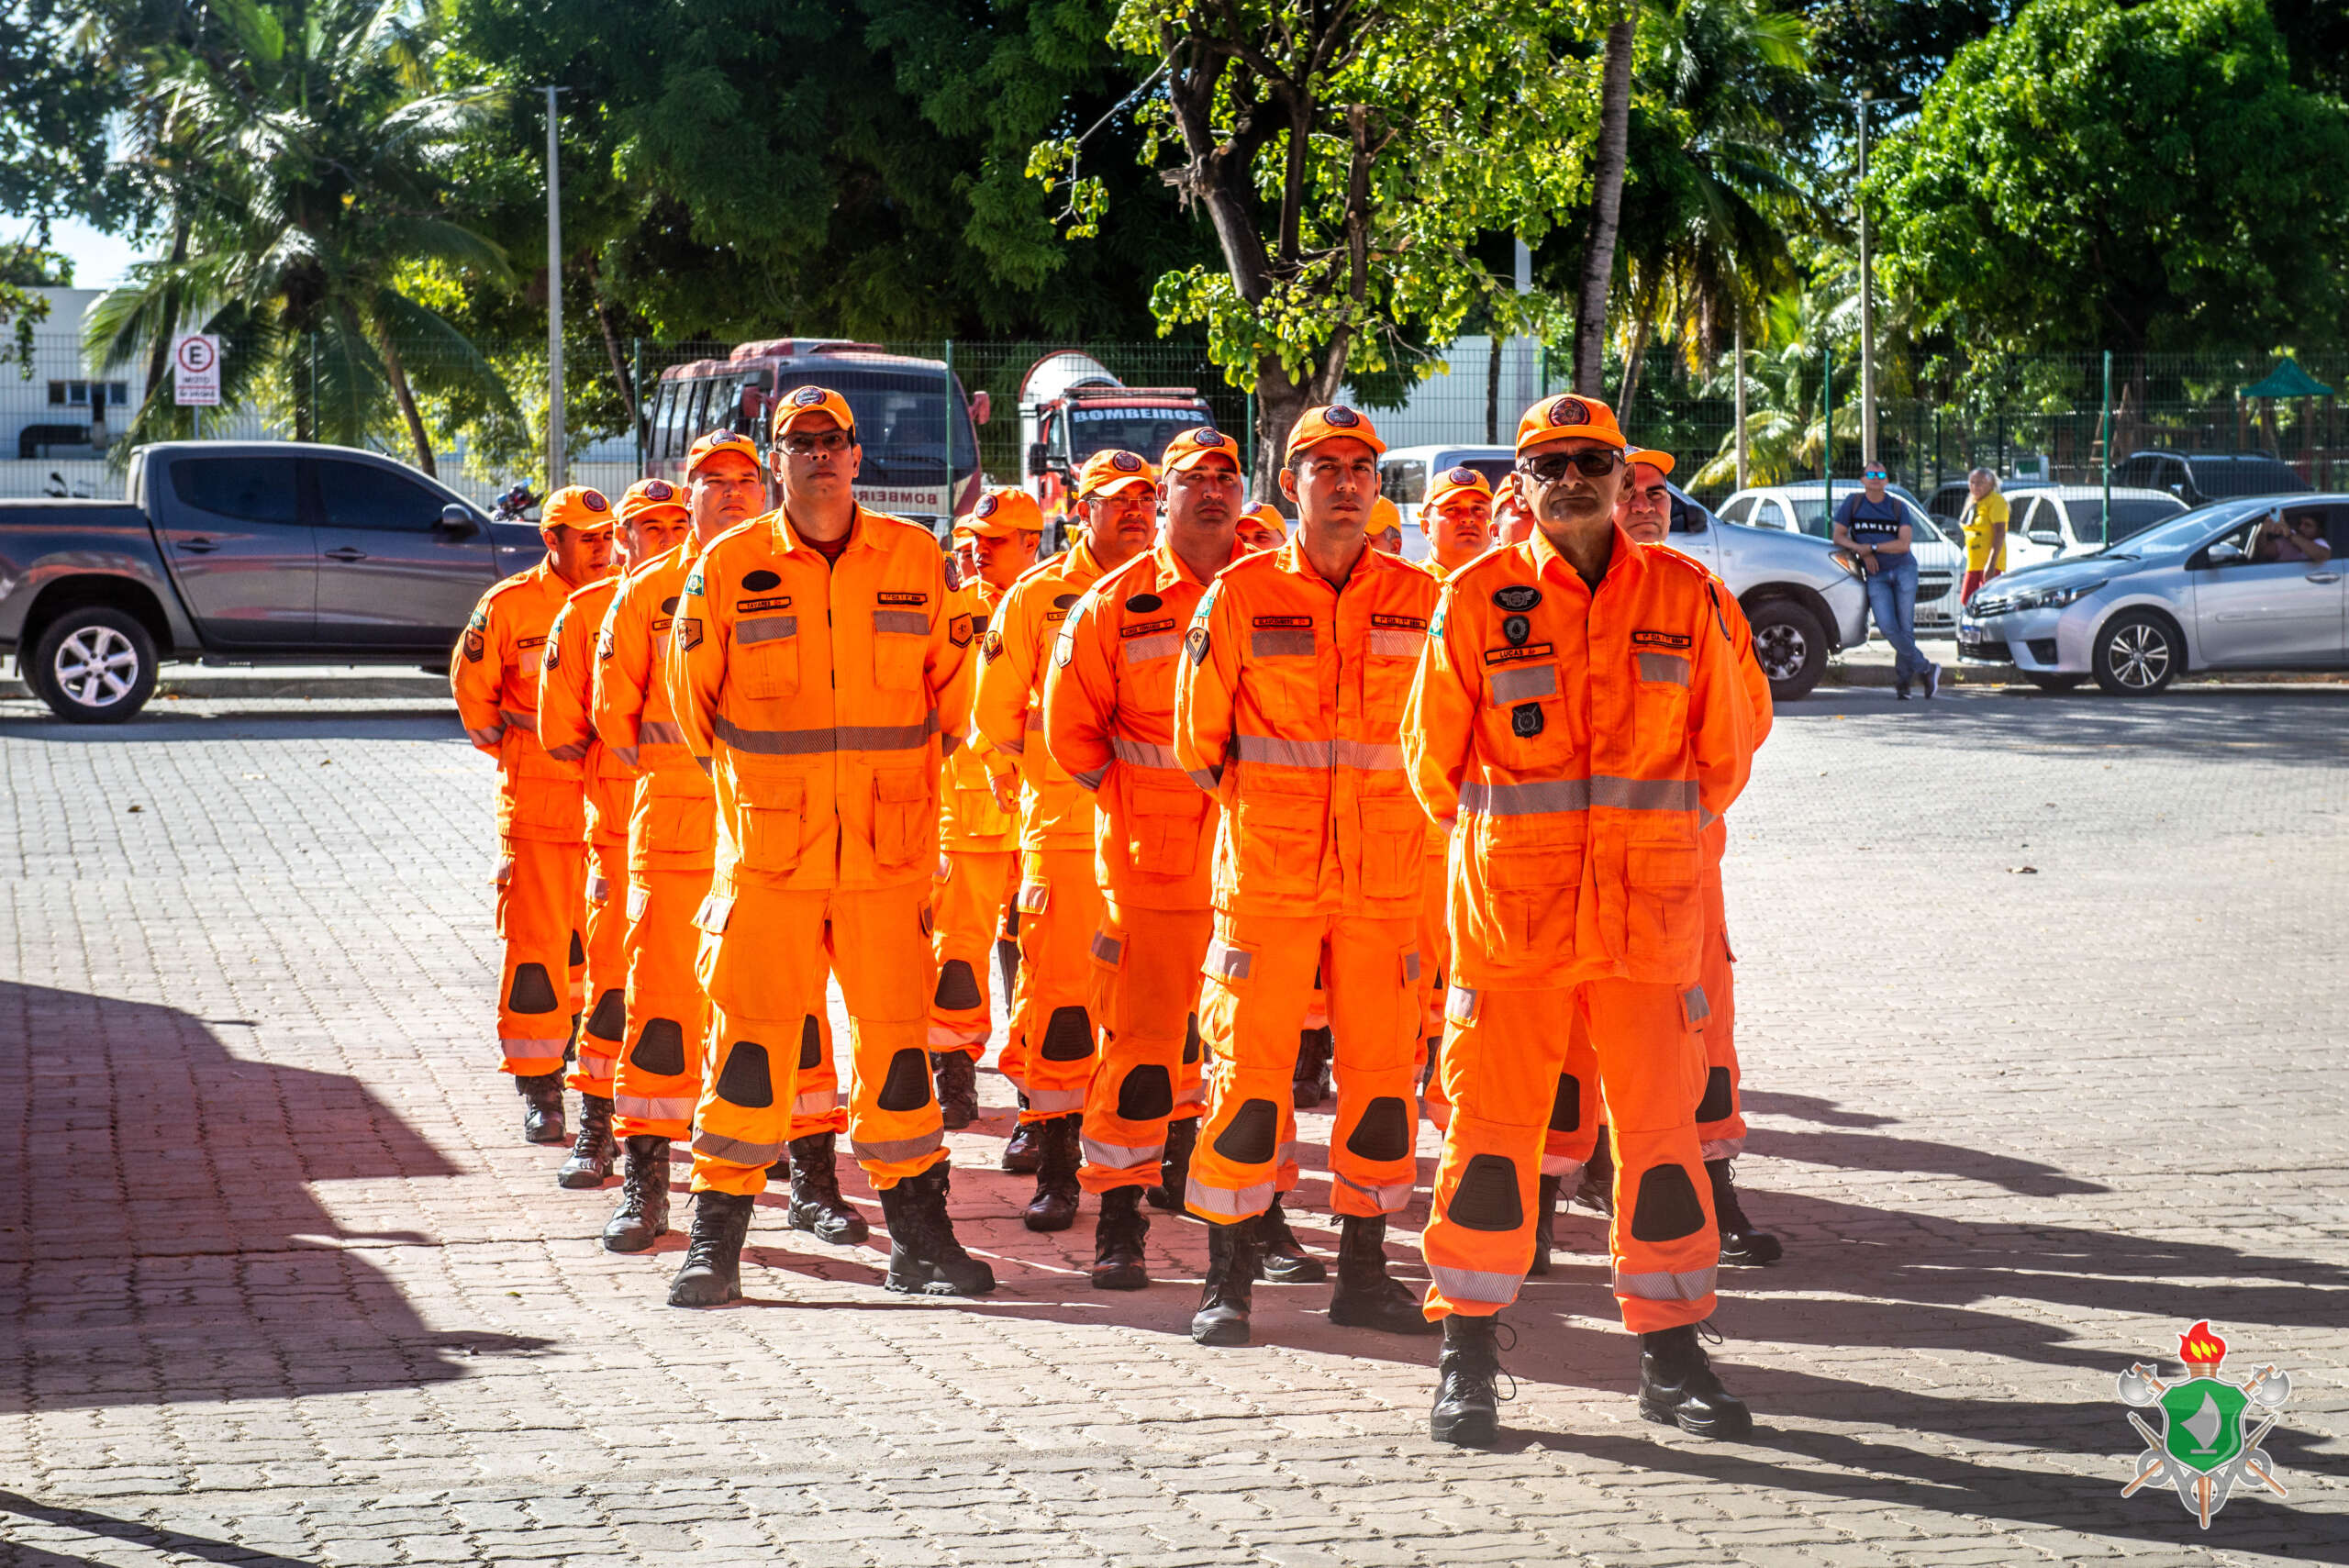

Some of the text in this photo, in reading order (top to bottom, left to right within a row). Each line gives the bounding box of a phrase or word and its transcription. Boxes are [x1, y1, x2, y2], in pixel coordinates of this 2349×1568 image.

[189, 346, 203, 364] E
[1073, 408, 1204, 423] BOMBEIROS
[747, 601, 771, 609] TAVARES
[1499, 649, 1523, 659] LUCAS
